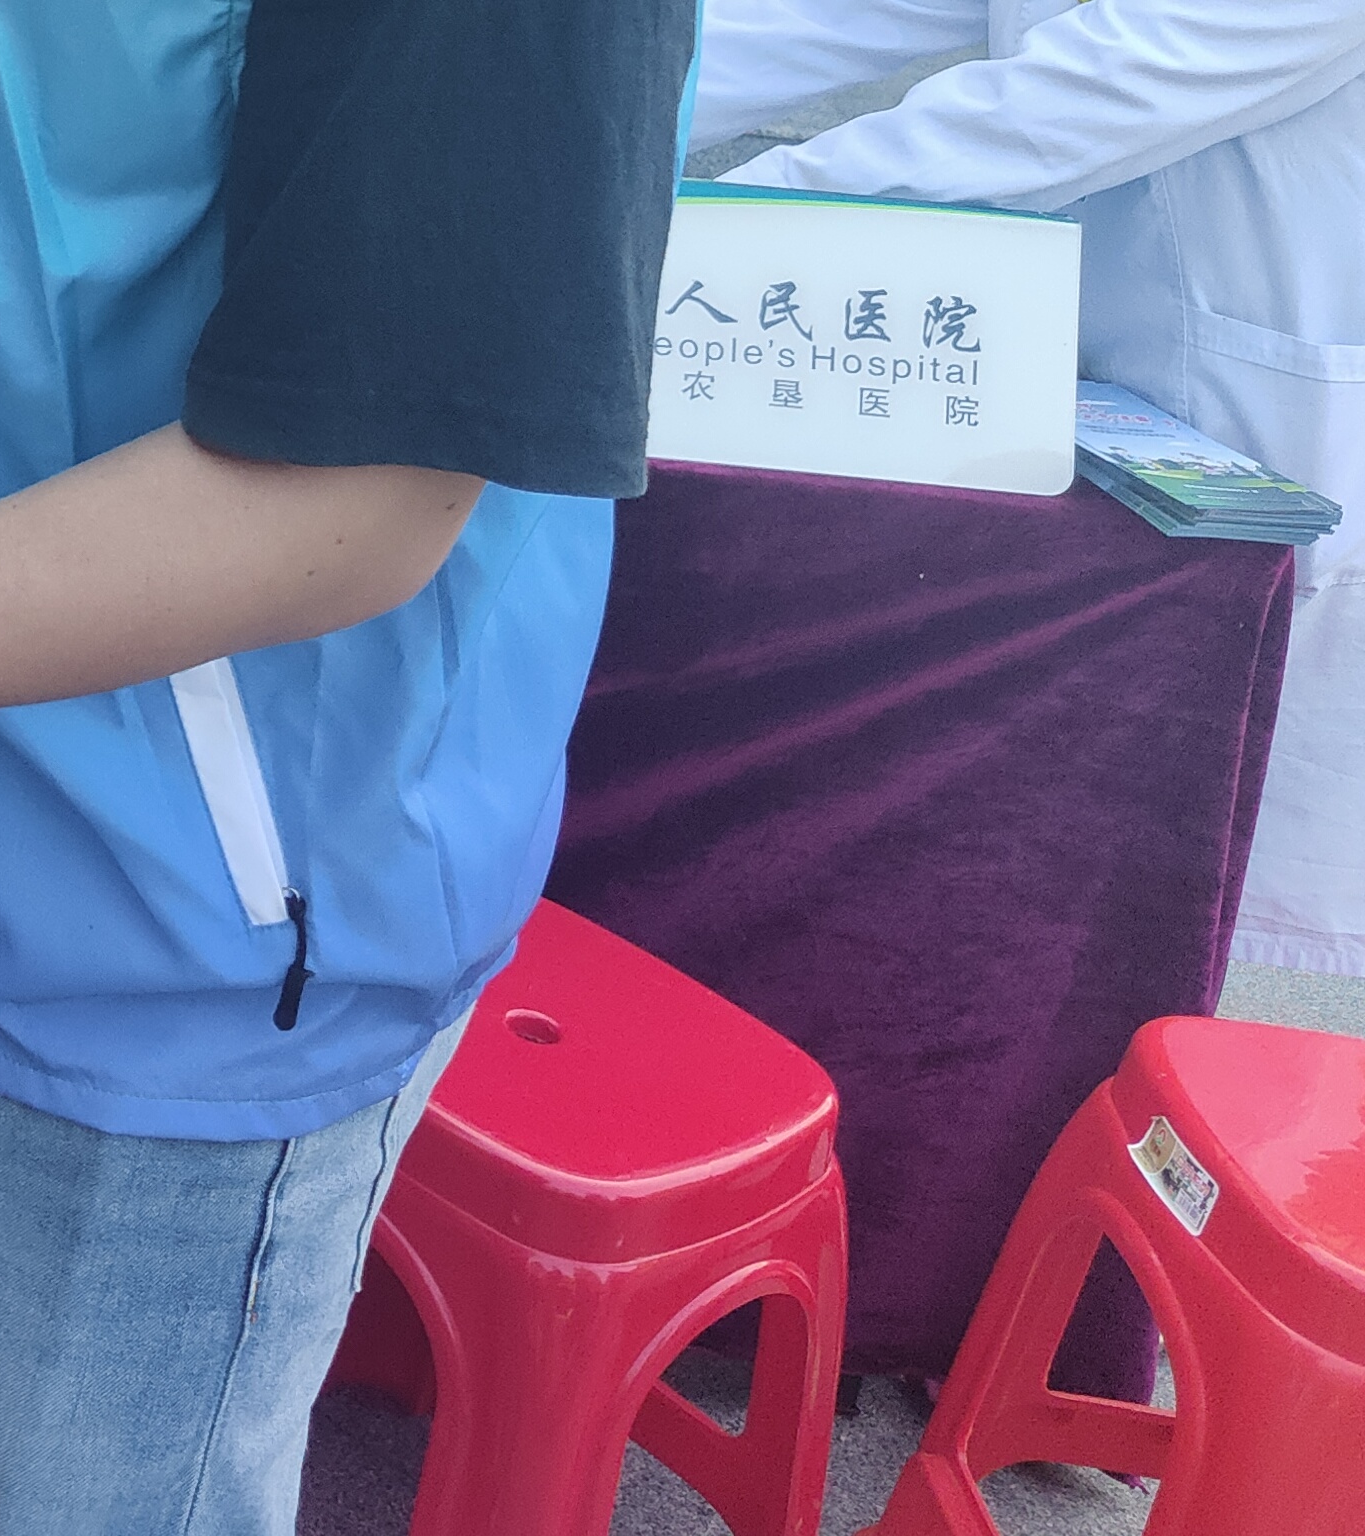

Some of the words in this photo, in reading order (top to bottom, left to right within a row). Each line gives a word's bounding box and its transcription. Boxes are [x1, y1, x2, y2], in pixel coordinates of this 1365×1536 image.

[665, 279, 982, 352] 人民医院
[653, 336, 796, 368] eople's
[811, 345, 978, 385] Hospital
[681, 370, 980, 427] 农垦医院
